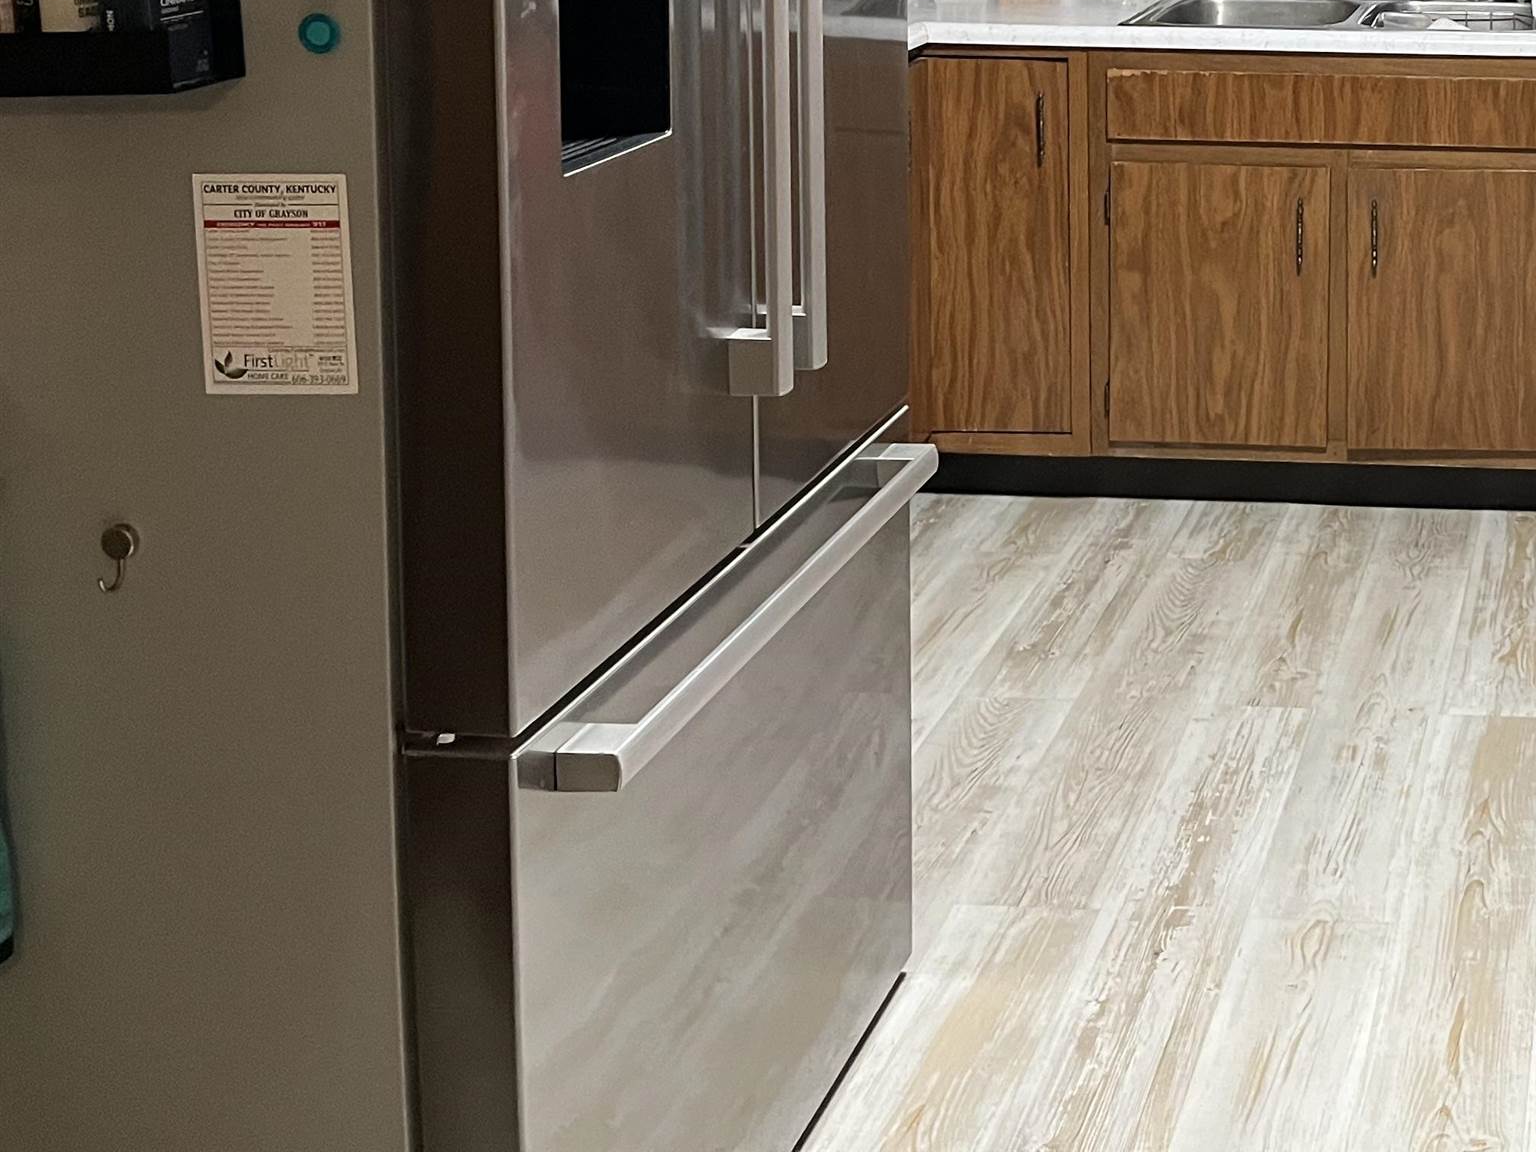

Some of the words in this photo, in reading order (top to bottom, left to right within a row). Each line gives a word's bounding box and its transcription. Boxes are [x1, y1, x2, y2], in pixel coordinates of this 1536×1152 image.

[203, 184, 239, 194] CARTER
[241, 184, 284, 195] COUNTY,
[286, 184, 336, 194] KENTUCKY
[233, 209, 253, 218] CITY
[255, 209, 267, 218] OF
[269, 209, 309, 218] GRAYSON
